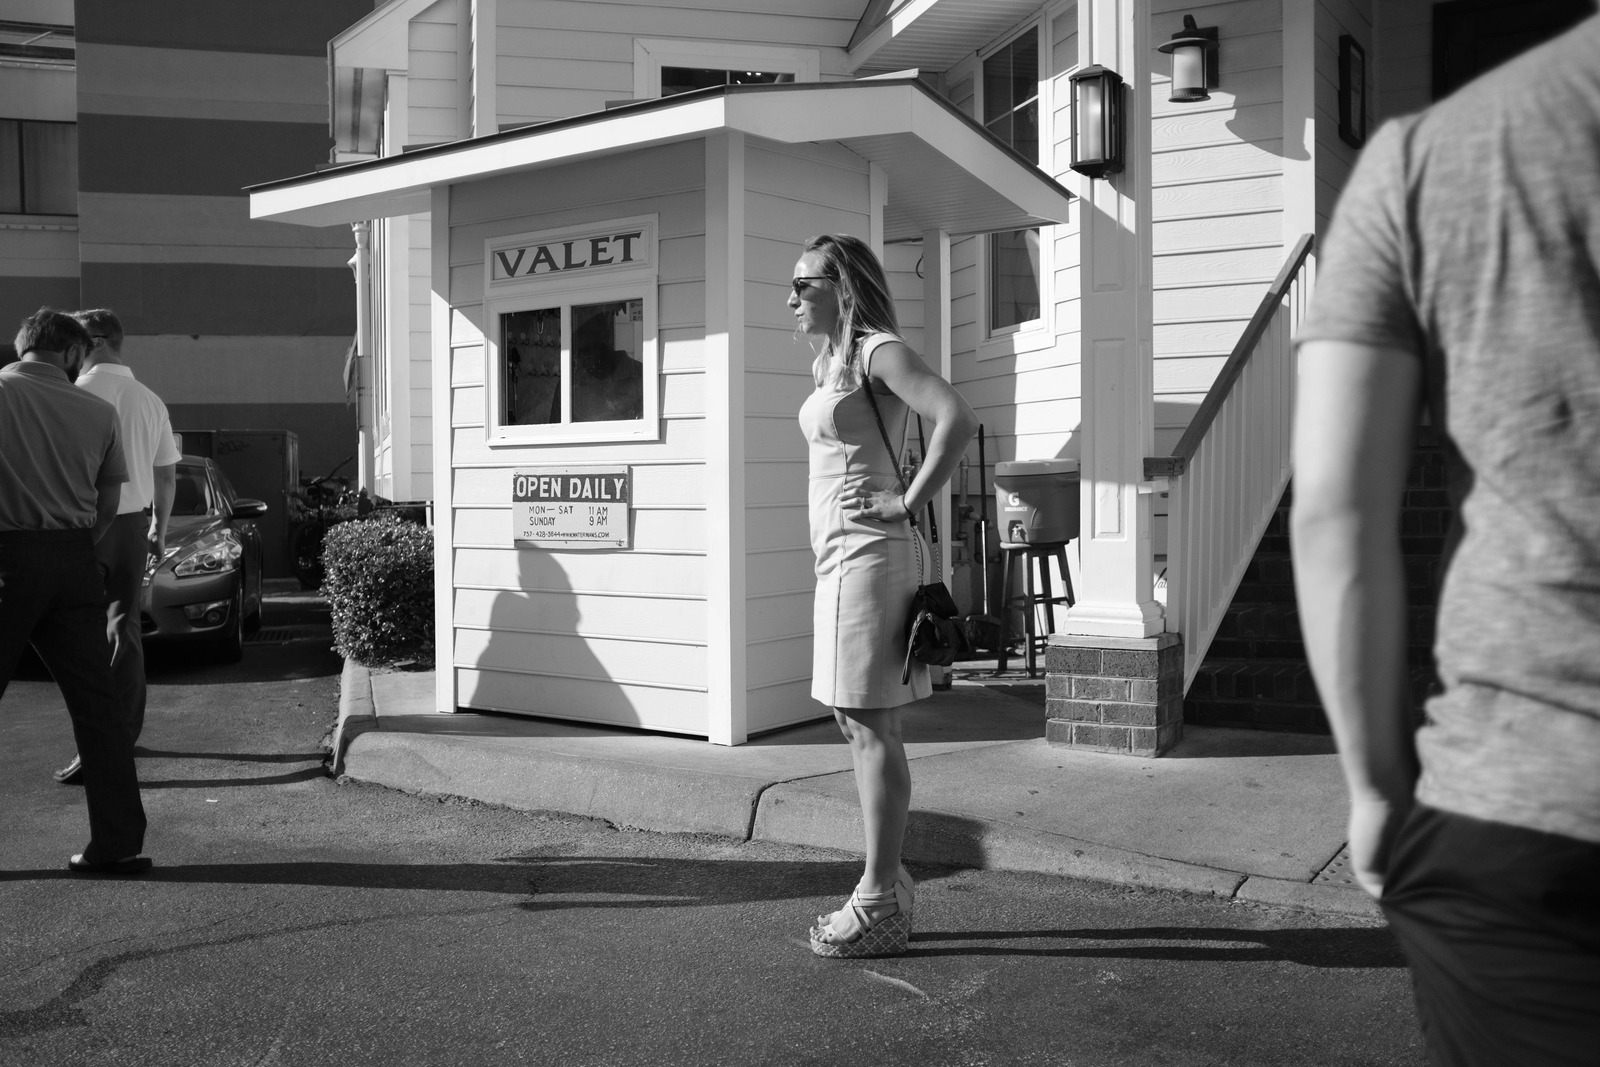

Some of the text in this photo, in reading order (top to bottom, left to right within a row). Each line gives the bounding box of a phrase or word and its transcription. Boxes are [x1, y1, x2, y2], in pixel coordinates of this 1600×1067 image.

[497, 232, 642, 277] VALET
[516, 477, 624, 499] OPEN DAILY
[1009, 492, 1020, 506] G
[558, 506, 573, 514] SAT
[588, 506, 594, 515] 11
[596, 507, 608, 515] AM
[529, 516, 608, 526] SUNDAY 9 AM
